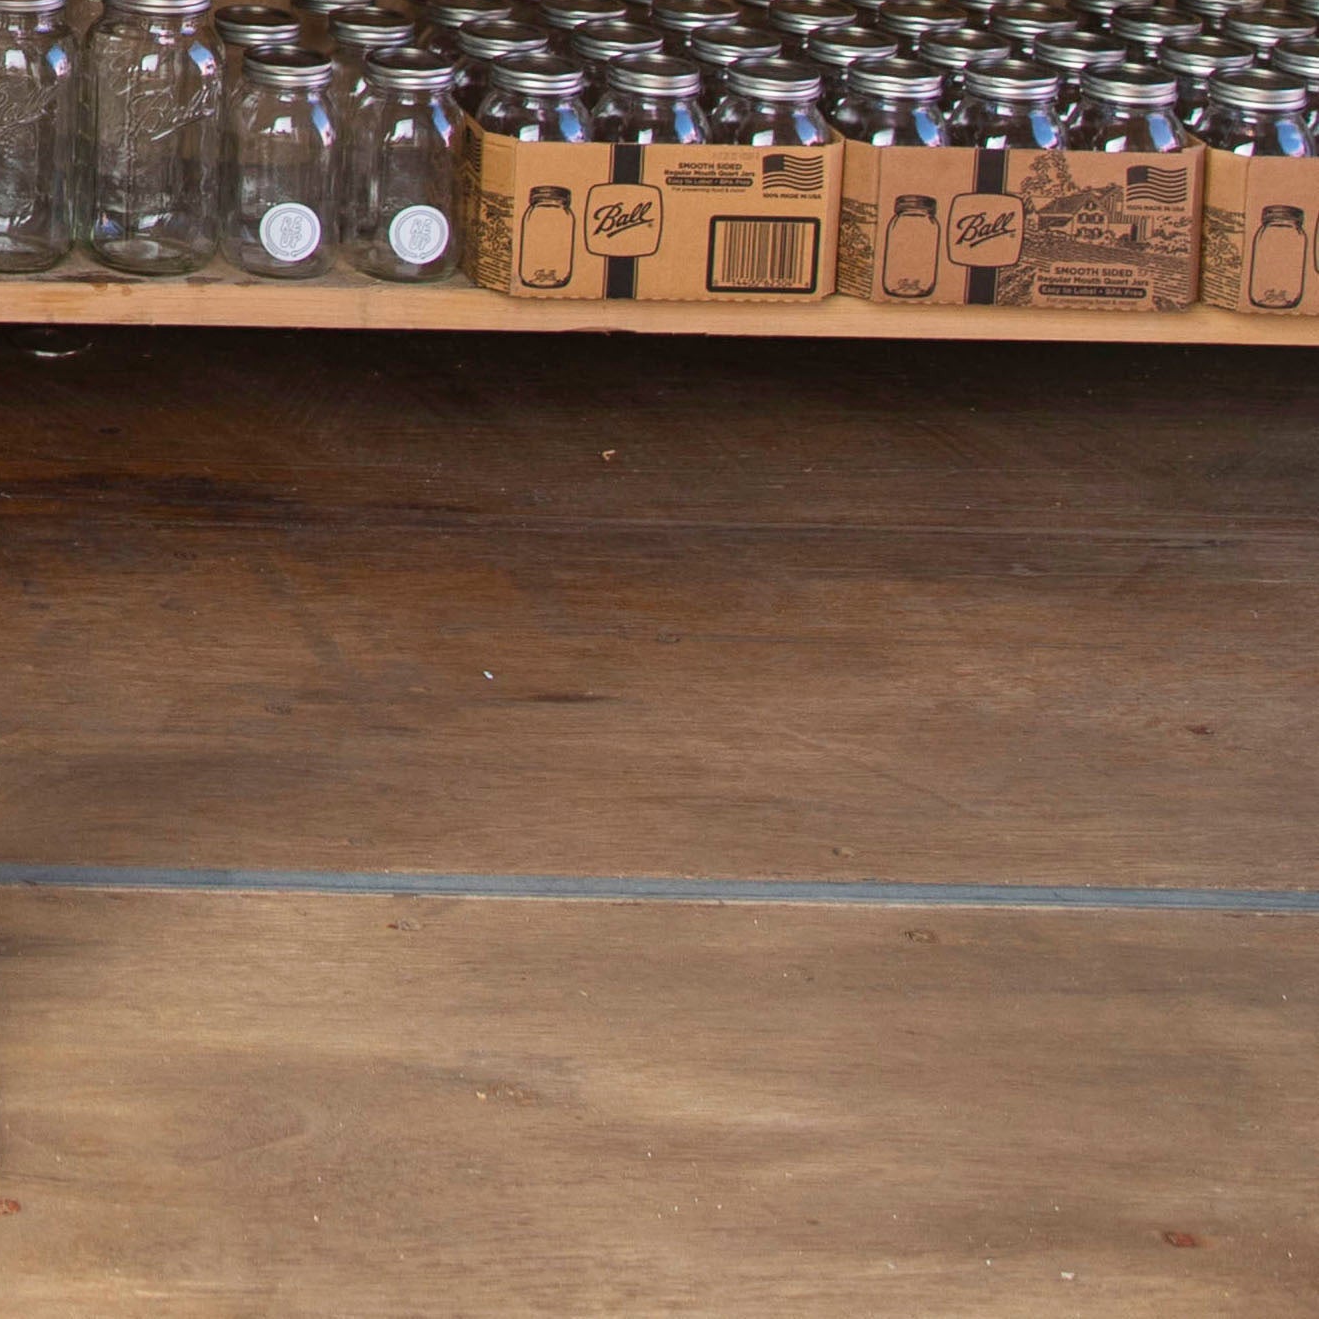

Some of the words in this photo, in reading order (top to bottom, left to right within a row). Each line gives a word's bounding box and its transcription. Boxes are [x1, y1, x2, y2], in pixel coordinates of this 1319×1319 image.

[281, 215, 303, 234] RE
[410, 218, 433, 235] RE
[593, 200, 655, 238] Ball
[956, 211, 1016, 248] Ball
[280, 233, 302, 250] UP
[409, 234, 431, 251] UP
[1055, 266, 1098, 276] SMOOTH
[1102, 268, 1133, 277] SIDED
[1038, 275, 1071, 283] Regular
[1073, 276, 1101, 284] Mouth
[1104, 277, 1128, 285] Quart
[1131, 278, 1149, 286] Jars
